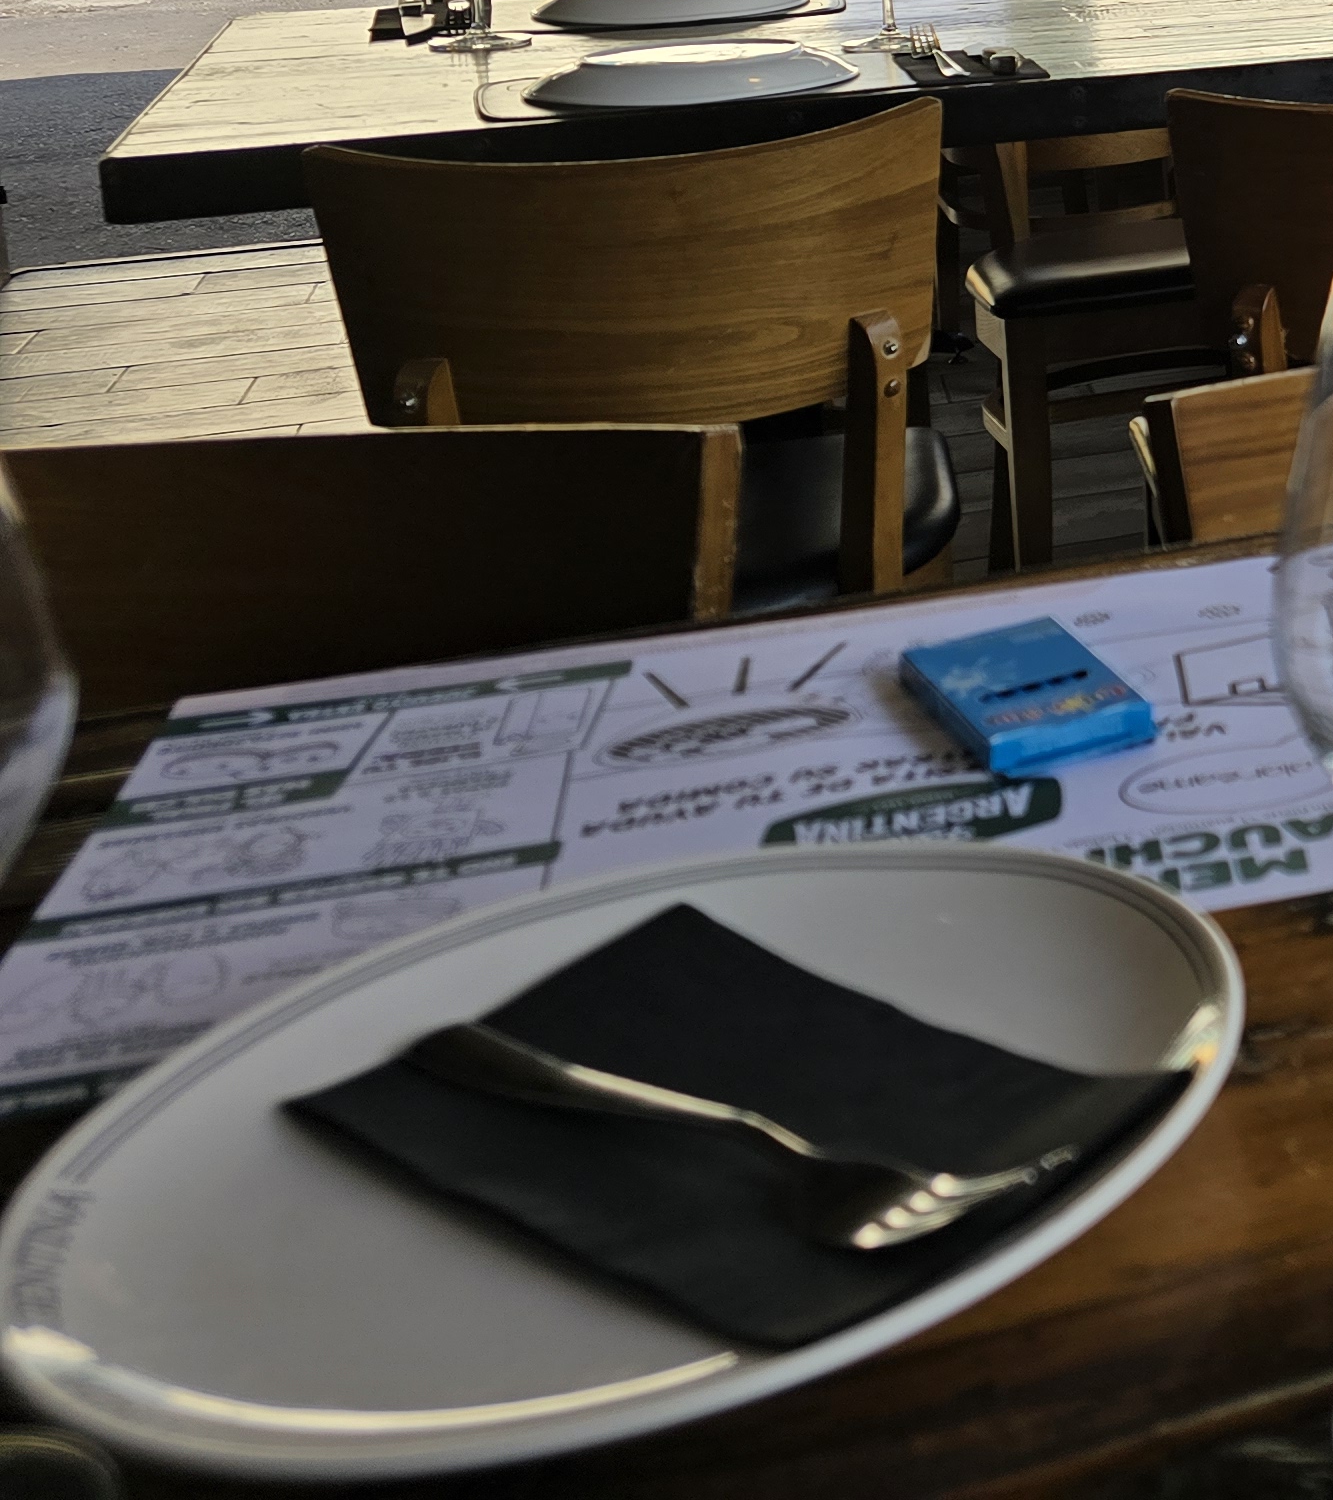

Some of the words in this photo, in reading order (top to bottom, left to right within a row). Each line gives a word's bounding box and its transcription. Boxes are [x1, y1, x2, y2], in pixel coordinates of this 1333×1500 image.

[617, 772, 774, 815] COMIDA
[792, 778, 1035, 846] ARGENTINA
[580, 798, 720, 838] AYUDA
